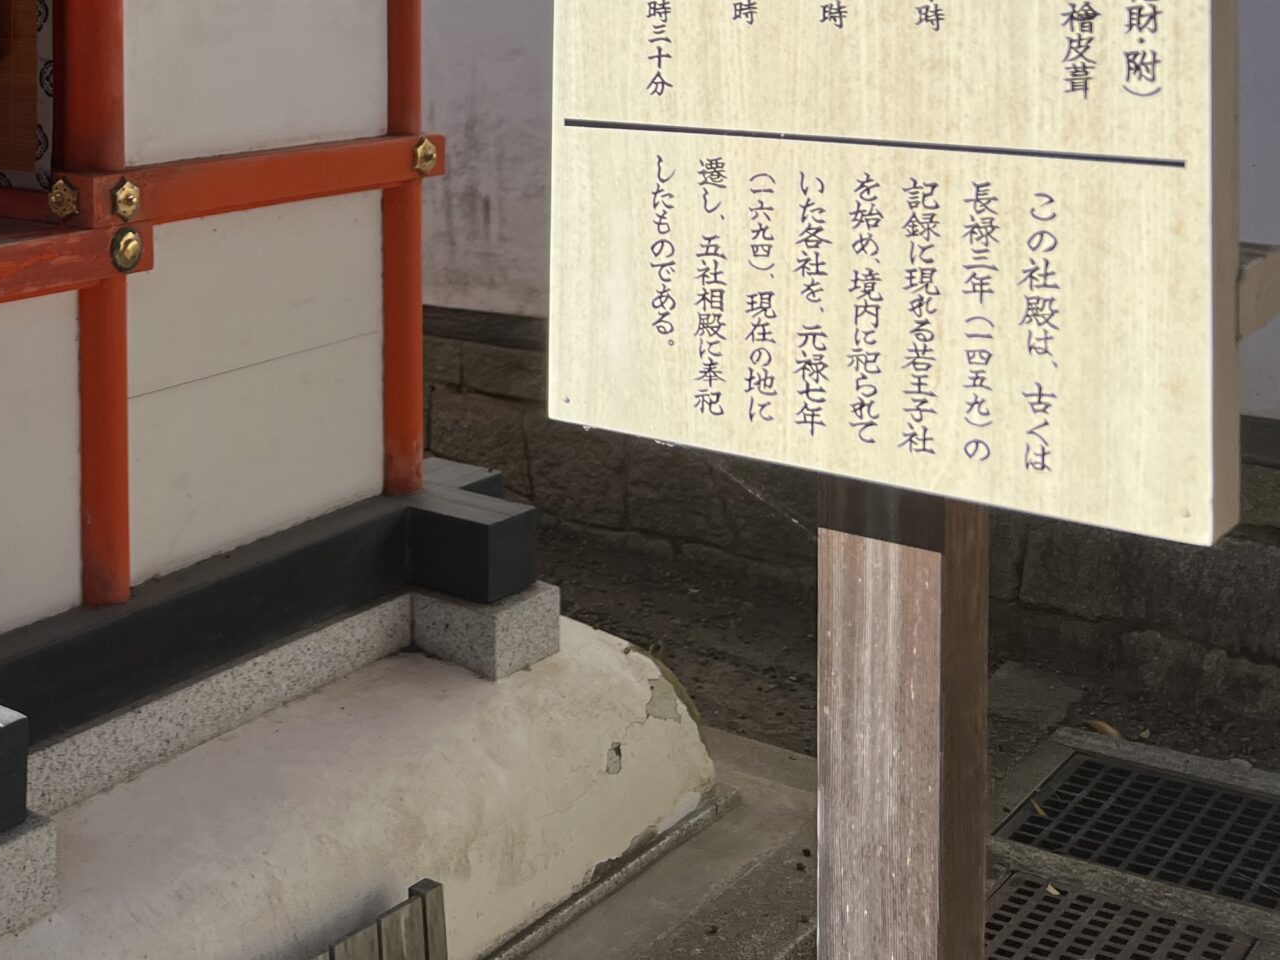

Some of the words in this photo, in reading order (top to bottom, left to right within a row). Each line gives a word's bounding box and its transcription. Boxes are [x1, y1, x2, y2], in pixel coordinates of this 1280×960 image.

[1060, 0, 1102, 100] 檜皮葺
[649, 154, 677, 347] したものである。
[897, 176, 941, 455] 記録に現れる若王子社
